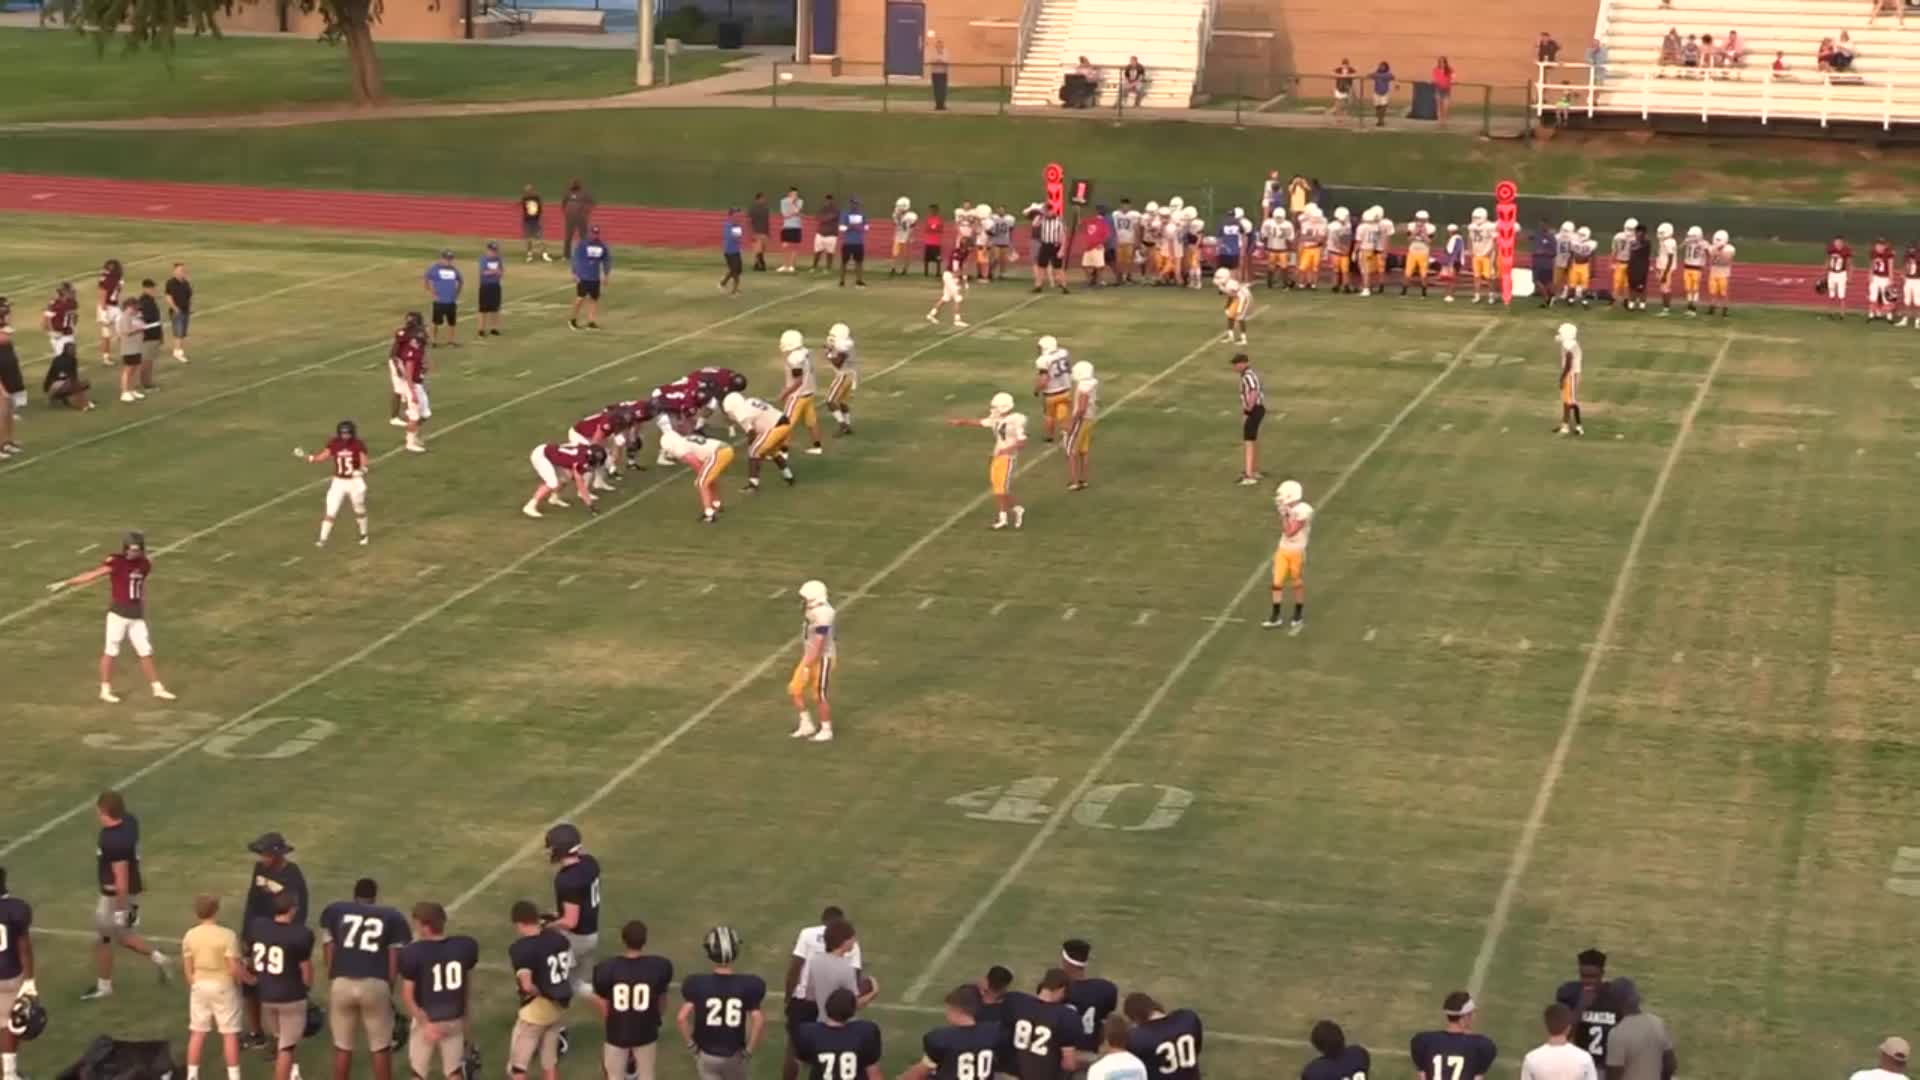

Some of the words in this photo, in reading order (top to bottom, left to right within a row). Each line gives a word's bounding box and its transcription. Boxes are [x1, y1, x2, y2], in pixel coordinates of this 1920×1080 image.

[82, 710, 338, 759] 30
[945, 776, 1195, 831] 40
[342, 914, 384, 952] 72
[252, 942, 284, 975] 29
[432, 961, 462, 992] 10
[612, 983, 650, 1012] 80
[705, 997, 743, 1028] 26
[1013, 1019, 1052, 1056] 82
[1588, 1026, 1603, 1056] 2
[818, 1052, 857, 1080] 78
[957, 1050, 994, 1080] 60
[1155, 1034, 1196, 1074] 30
[1432, 1054, 1465, 1080] 17
